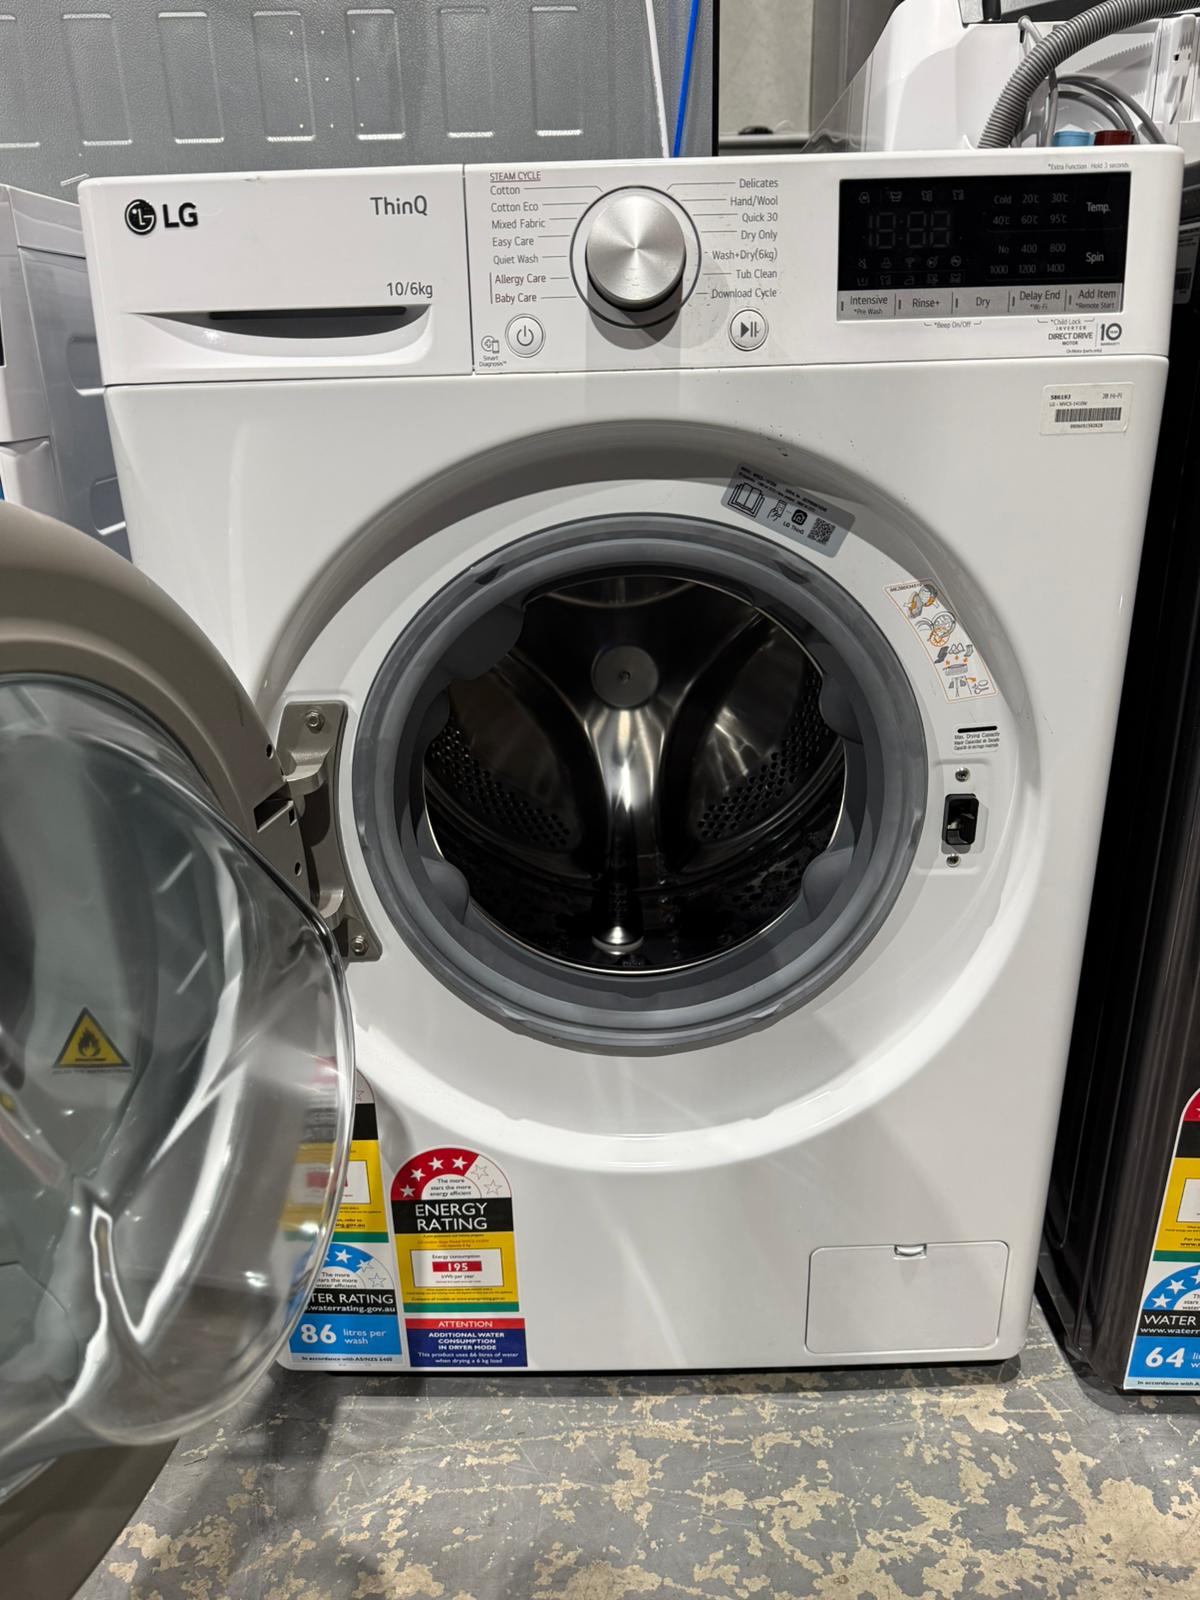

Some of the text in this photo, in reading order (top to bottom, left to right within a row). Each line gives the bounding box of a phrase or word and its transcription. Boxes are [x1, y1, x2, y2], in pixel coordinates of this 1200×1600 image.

[490, 171, 541, 182] STEAM CYCLE
[739, 178, 778, 188] Delicates
[490, 186, 521, 196] Cotton
[730, 195, 778, 206] Hand/Wool
[994, 194, 1012, 204] Cold
[370, 195, 428, 216] ThinQ
[491, 202, 539, 213] Cotton Eco
[1086, 201, 1111, 213] Temp.
[162, 202, 199, 228] LG
[742, 212, 778, 222] Quick 30
[492, 219, 546, 229] Mixed Fabric
[741, 229, 778, 242] Dry Only
[492, 237, 534, 248] Easy Care
[712, 248, 778, 261] Wash+Dry(6kg)
[998, 243, 1067, 255] No 400 800
[493, 255, 539, 265] Quiet Wash
[1085, 252, 1105, 264] Spin
[736, 268, 778, 279] Tub Clean
[990, 263, 1065, 275] 1000 1200 1400
[495, 273, 547, 286] Allergy Care
[386, 282, 434, 298] 10/6kg
[712, 288, 777, 300] Download Cycle
[1020, 290, 1060, 301] Delay End
[1078, 289, 1117, 299] Add Item
[495, 293, 537, 305] Baby Care
[850, 295, 889, 305] Intensive
[912, 298, 940, 308] Rinse+
[976, 296, 990, 307] Dry
[1048, 332, 1094, 341] DIRECT DRIVE
[415, 1202, 488, 1217] ENERGY
[417, 1217, 488, 1231] RATING
[447, 1262, 469, 1272] 195
[311, 1293, 394, 1304] TER RATING
[438, 1320, 493, 1328] ATTENTION
[1144, 1315, 1196, 1327] WATER
[300, 1323, 337, 1344] 86
[343, 1329, 387, 1338] litres per
[1140, 1327, 1200, 1335] www.waterr
[344, 1337, 369, 1345] wash
[1145, 1346, 1185, 1369] 64
